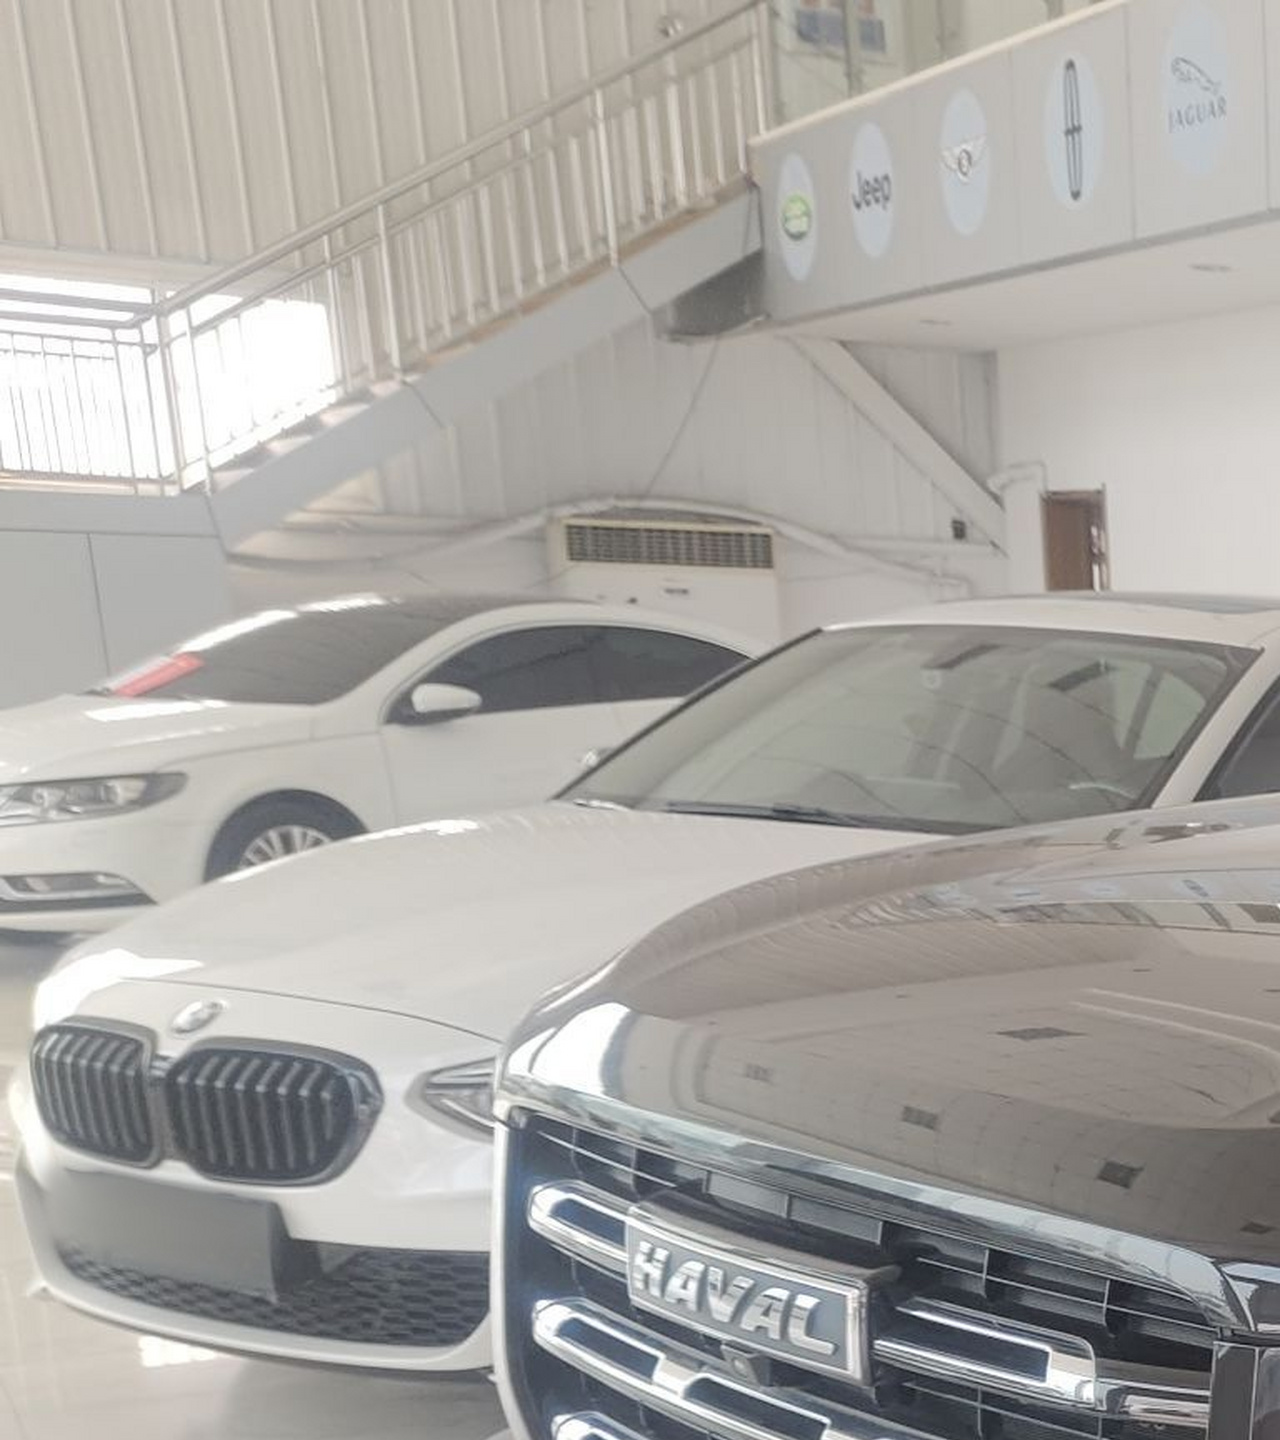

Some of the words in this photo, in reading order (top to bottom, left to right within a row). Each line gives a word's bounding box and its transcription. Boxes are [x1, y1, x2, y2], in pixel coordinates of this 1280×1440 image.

[1168, 96, 1227, 134] JAGUAR
[852, 170, 891, 211] Jeep
[633, 1241, 836, 1355] HAVAL
